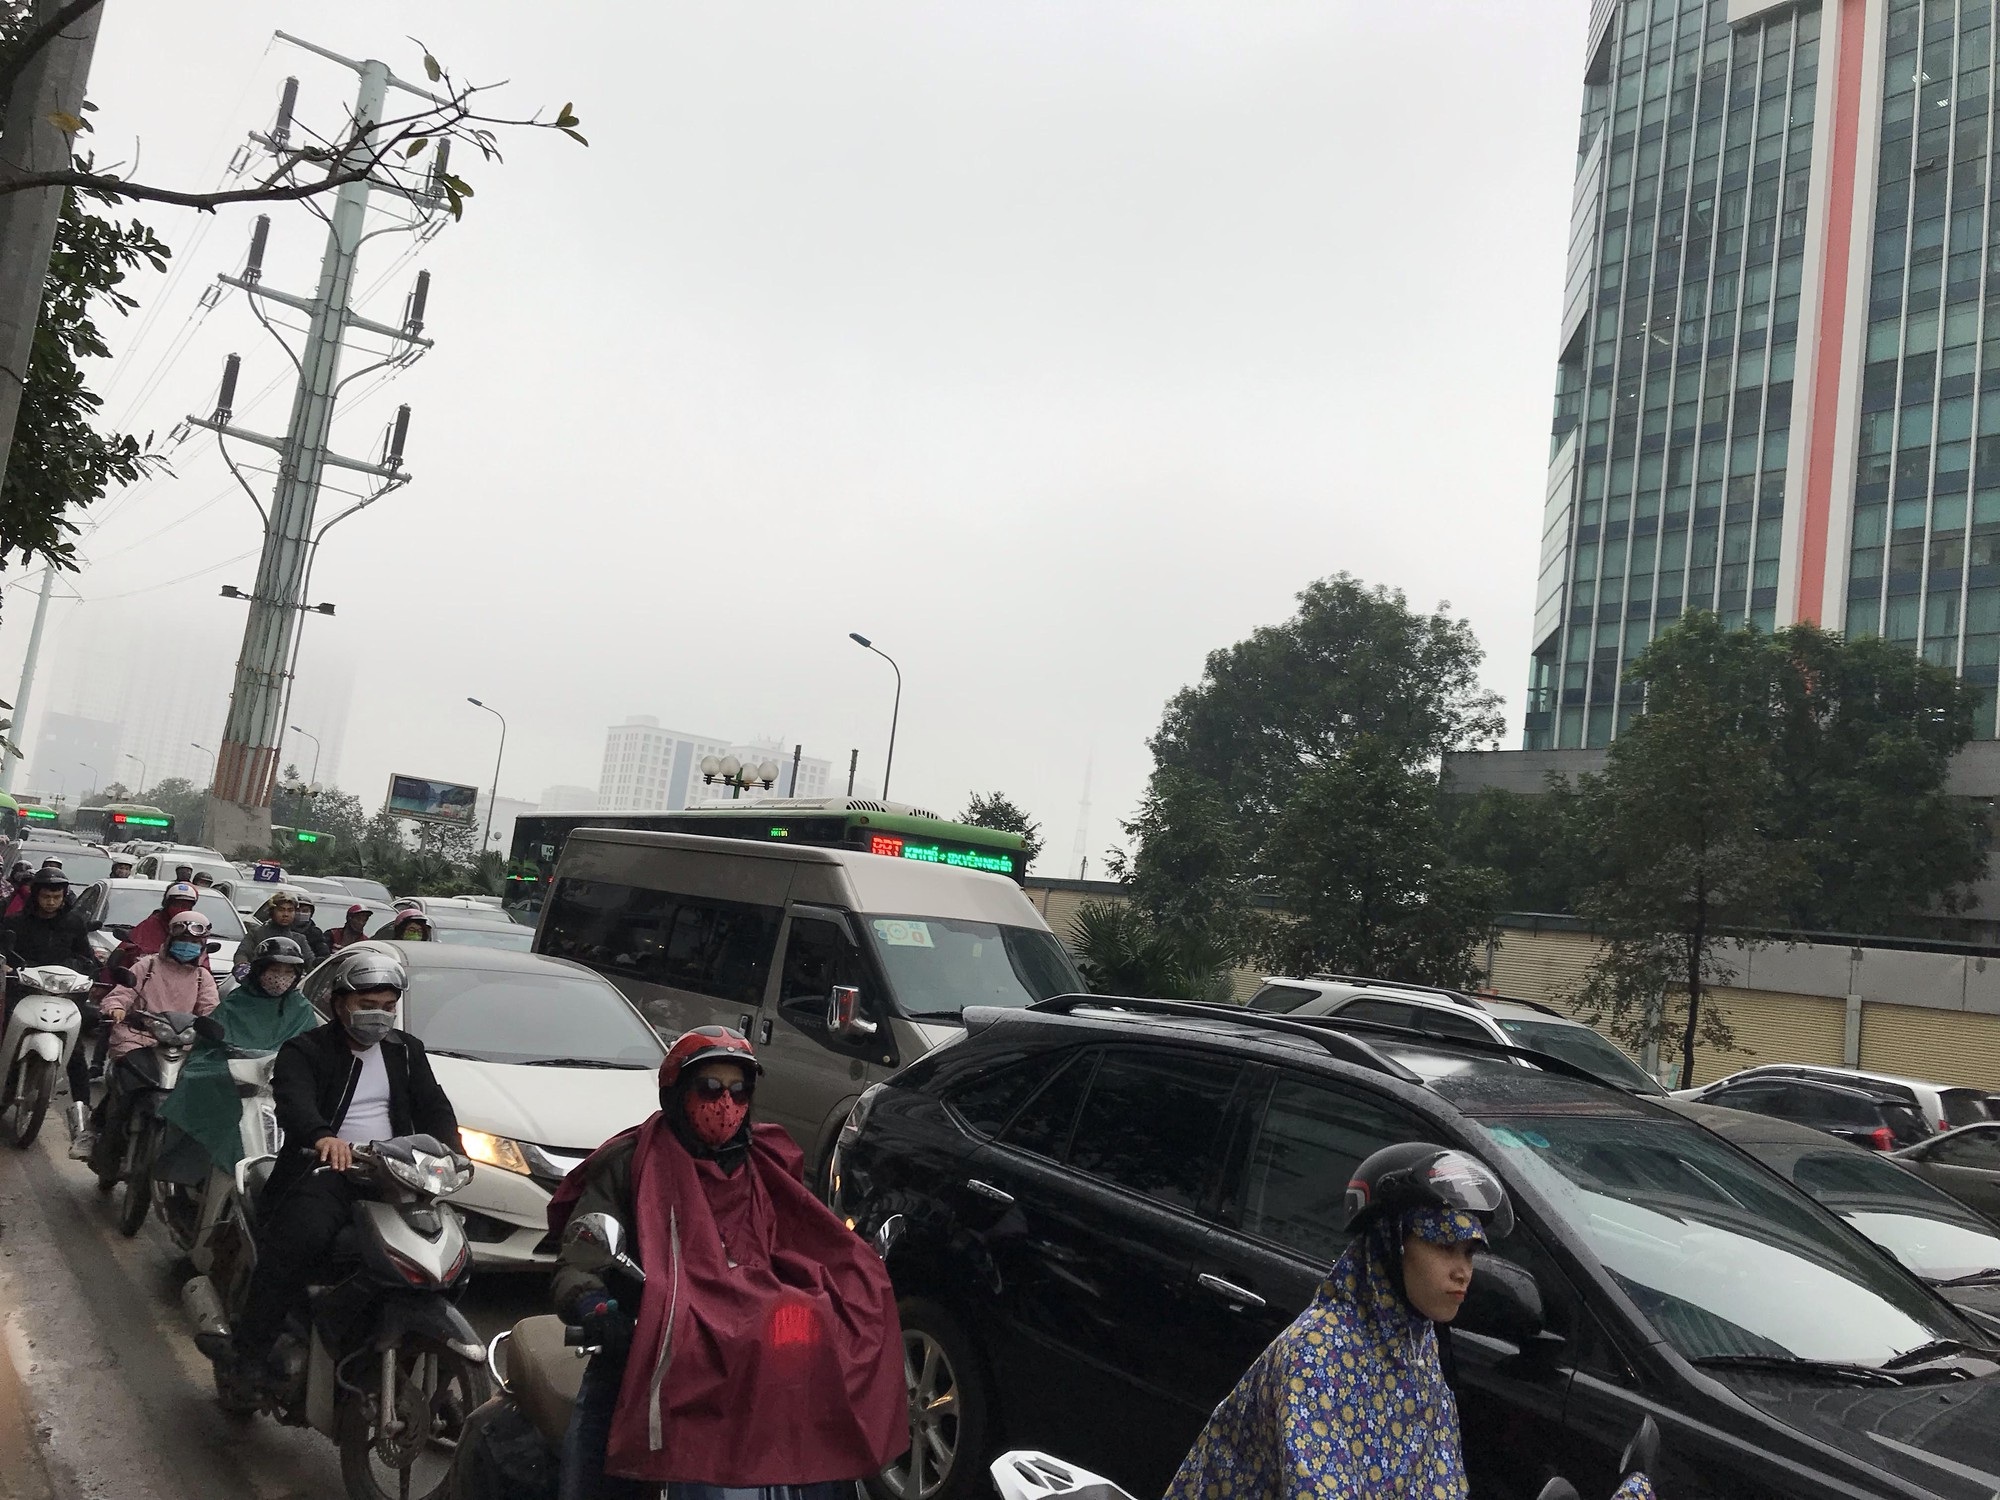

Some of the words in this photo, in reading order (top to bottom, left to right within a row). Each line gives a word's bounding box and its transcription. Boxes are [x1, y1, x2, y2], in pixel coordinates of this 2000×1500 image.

[871, 837, 902, 857] BRT
[904, 847, 922, 860] KIM
[261, 867, 275, 881] G7
